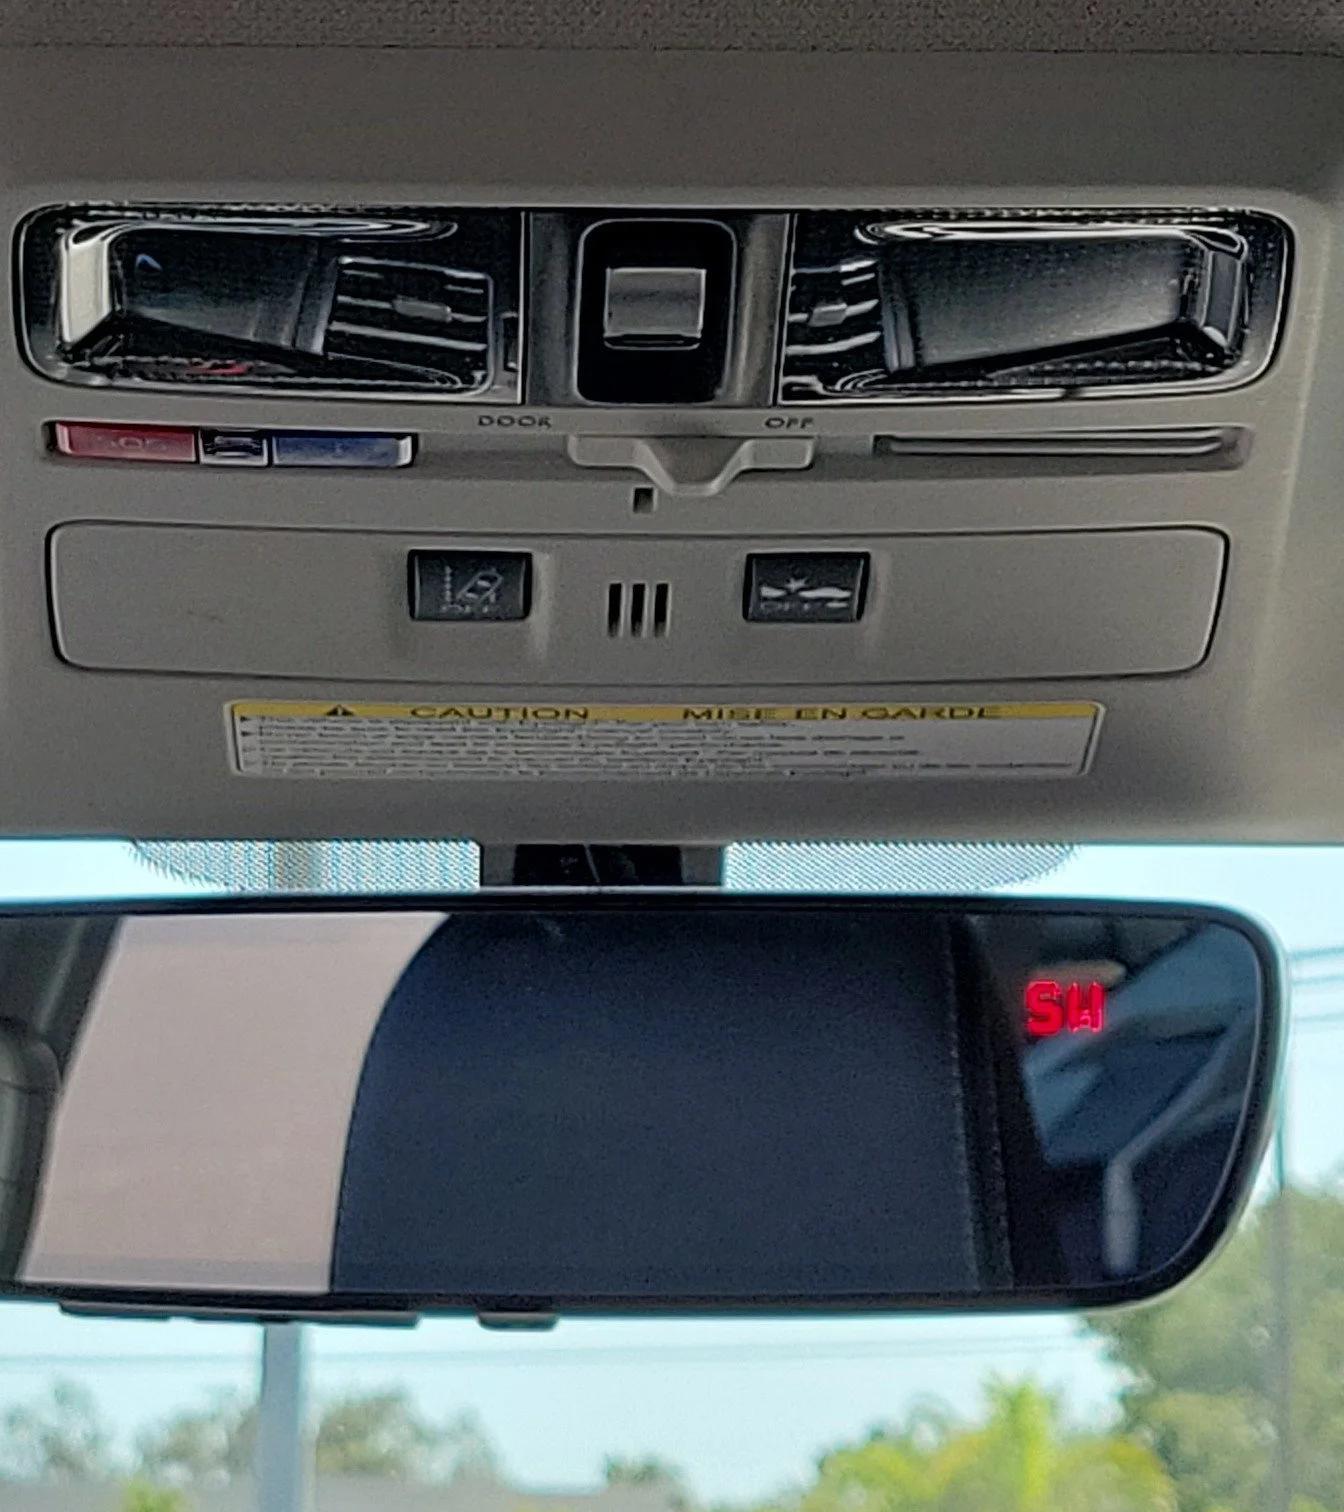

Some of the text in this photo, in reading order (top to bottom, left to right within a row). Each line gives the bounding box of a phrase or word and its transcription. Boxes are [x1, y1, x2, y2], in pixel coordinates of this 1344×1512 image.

[477, 414, 552, 429] DOOR
[764, 416, 815, 430] OFF
[410, 706, 1002, 720] CAUTION MISE EN GARDE
